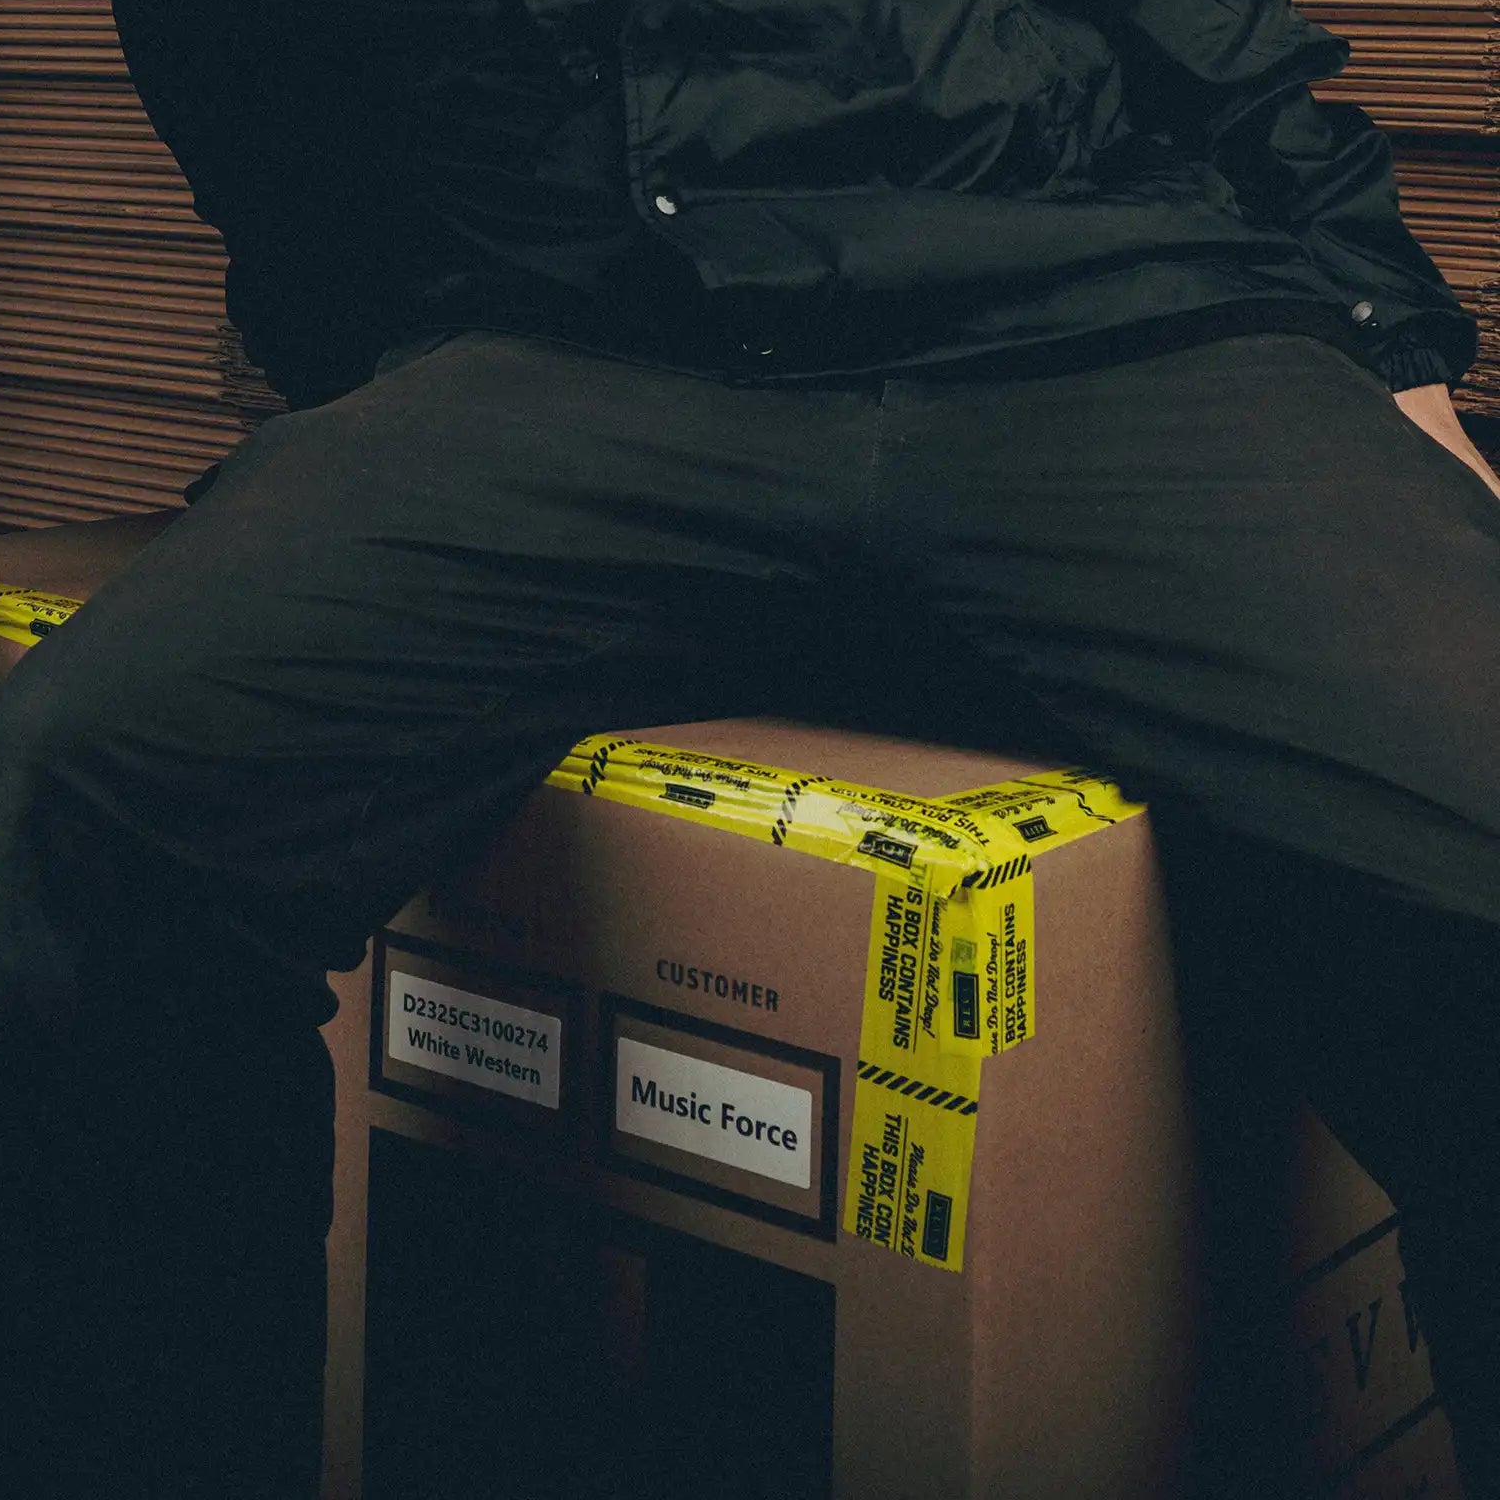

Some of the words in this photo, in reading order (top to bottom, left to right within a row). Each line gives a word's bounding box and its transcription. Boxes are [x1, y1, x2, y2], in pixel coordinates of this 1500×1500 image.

[954, 816, 990, 847] THIS
[879, 895, 904, 1002] HAPPINESS
[902, 911, 922, 949] BOX
[929, 937, 943, 961] Do
[1005, 903, 1016, 999] CONTAINS
[986, 932, 1000, 976] Drop!
[656, 959, 779, 1012] CUSTOMER
[894, 954, 917, 1050] CONTAINS
[986, 976, 998, 1004] Not
[403, 993, 549, 1053] D2325C3100274
[920, 992, 939, 1038] Drop!
[986, 1006, 998, 1028] Do
[1005, 1005, 1016, 1043] BOX
[407, 1026, 461, 1061] White
[465, 1045, 541, 1085] Western
[632, 1075, 711, 1125] Music
[721, 1104, 798, 1151] Force
[882, 1113, 901, 1157] THIS
[879, 1159, 898, 1201] BOX
[907, 1141, 925, 1189] Please
[856, 1143, 880, 1240] HAPPINES
